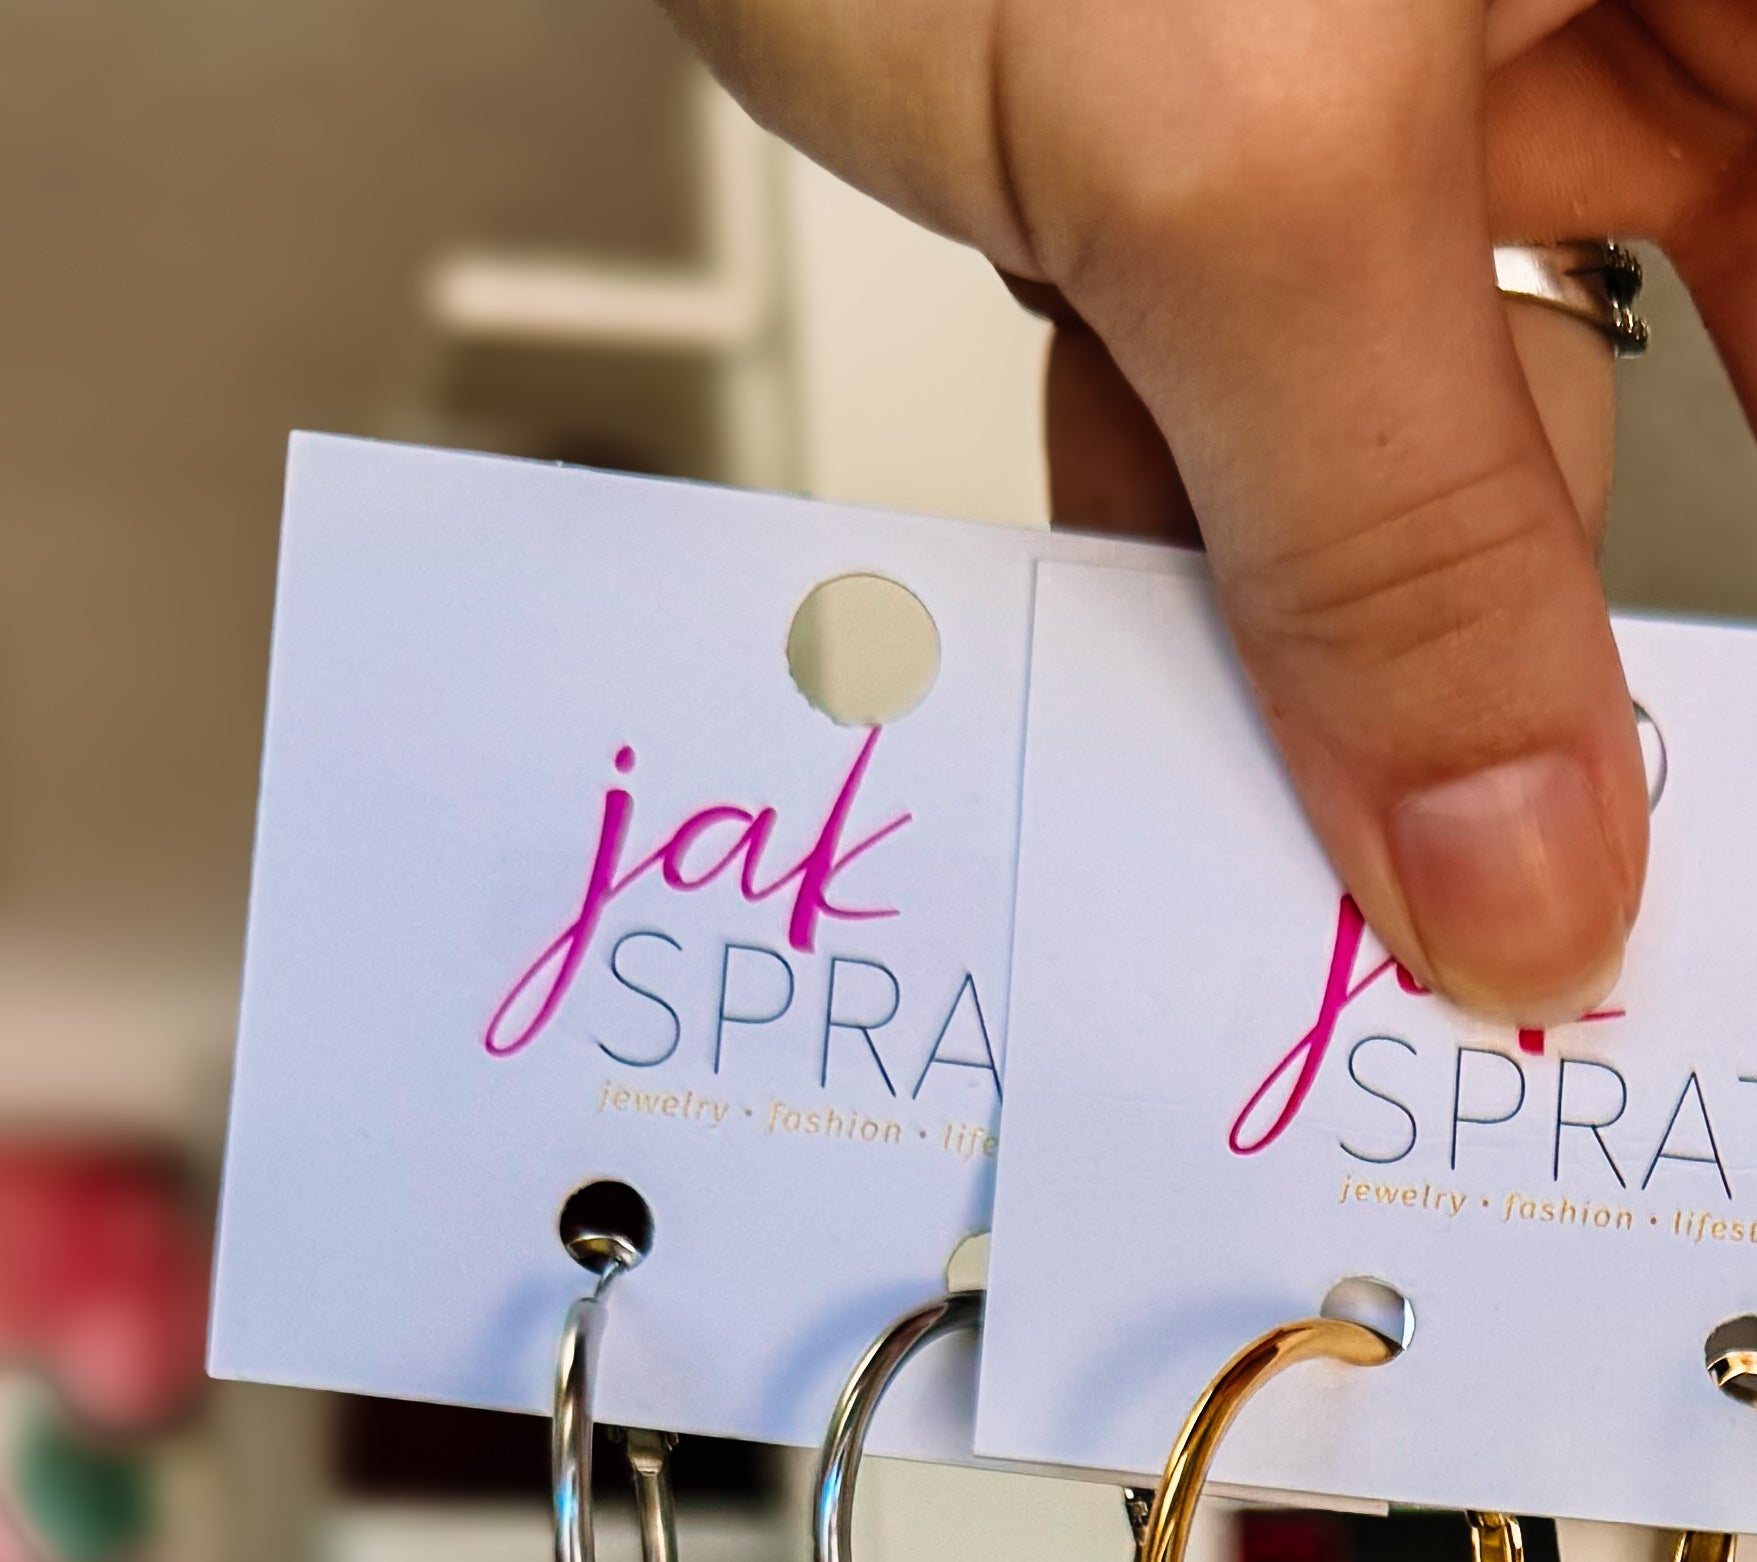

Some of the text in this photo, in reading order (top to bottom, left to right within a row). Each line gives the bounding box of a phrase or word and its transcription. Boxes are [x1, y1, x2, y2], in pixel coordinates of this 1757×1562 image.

[484, 723, 913, 1058] jak
[596, 930, 1004, 1105] SPRA
[598, 1080, 730, 1123] jewelry
[766, 1101, 904, 1145] fashion
[1338, 1173, 1467, 1218] jewelry
[1501, 1190, 1634, 1231] fashion
